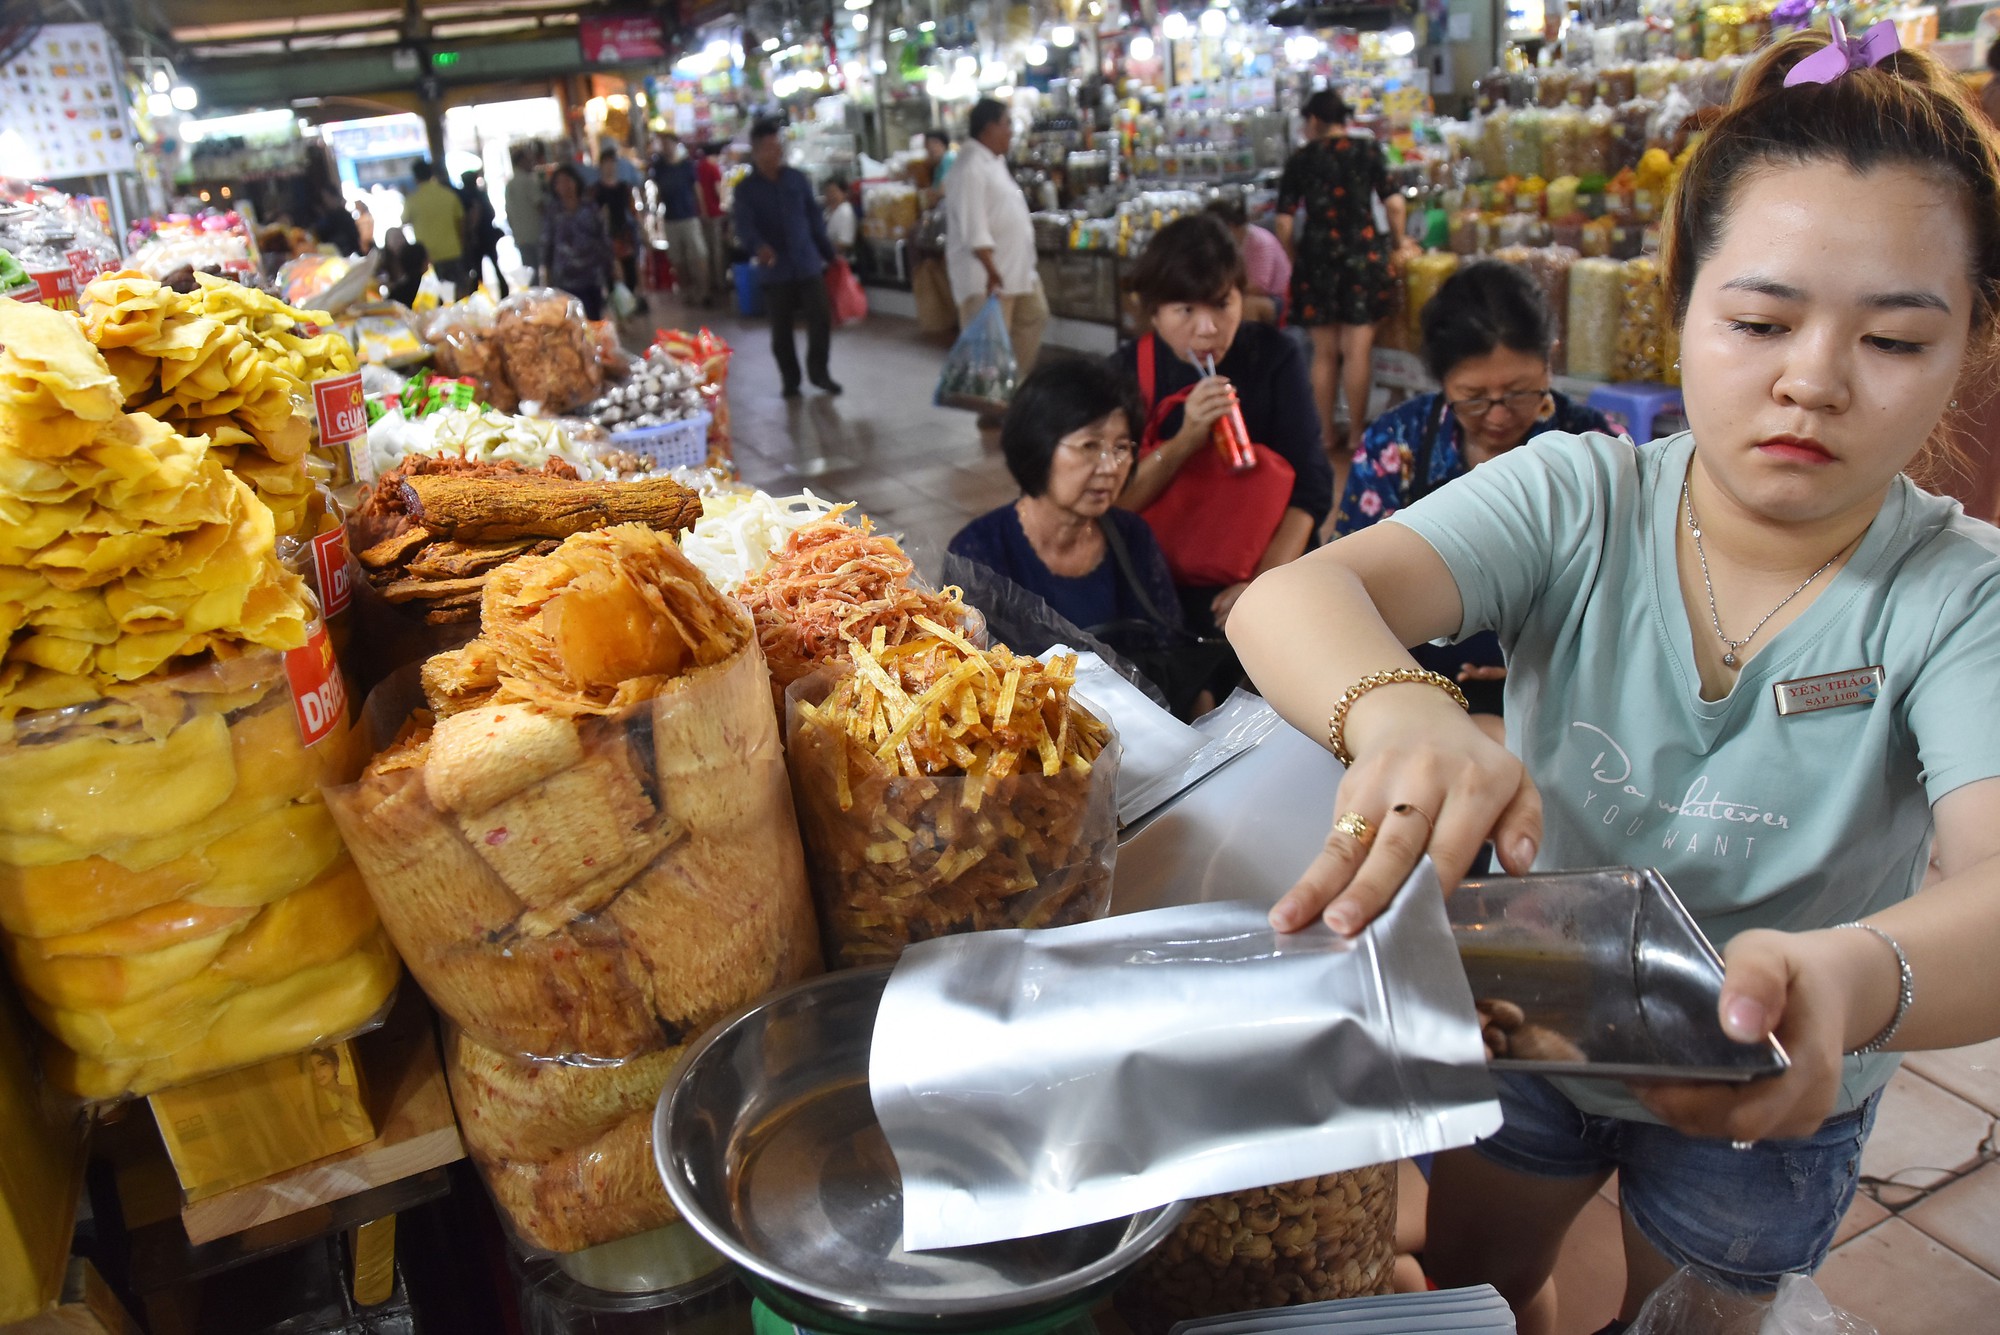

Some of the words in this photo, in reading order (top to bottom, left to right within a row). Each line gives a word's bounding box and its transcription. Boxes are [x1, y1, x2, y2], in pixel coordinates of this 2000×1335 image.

[1789, 682, 1821, 698] YẾN
[1826, 673, 1872, 692] THẢO
[1834, 691, 1859, 702] 1160
[1658, 775, 1790, 830] whatever
[1583, 790, 1644, 837] YOU
[1662, 829, 1756, 859] WANT
